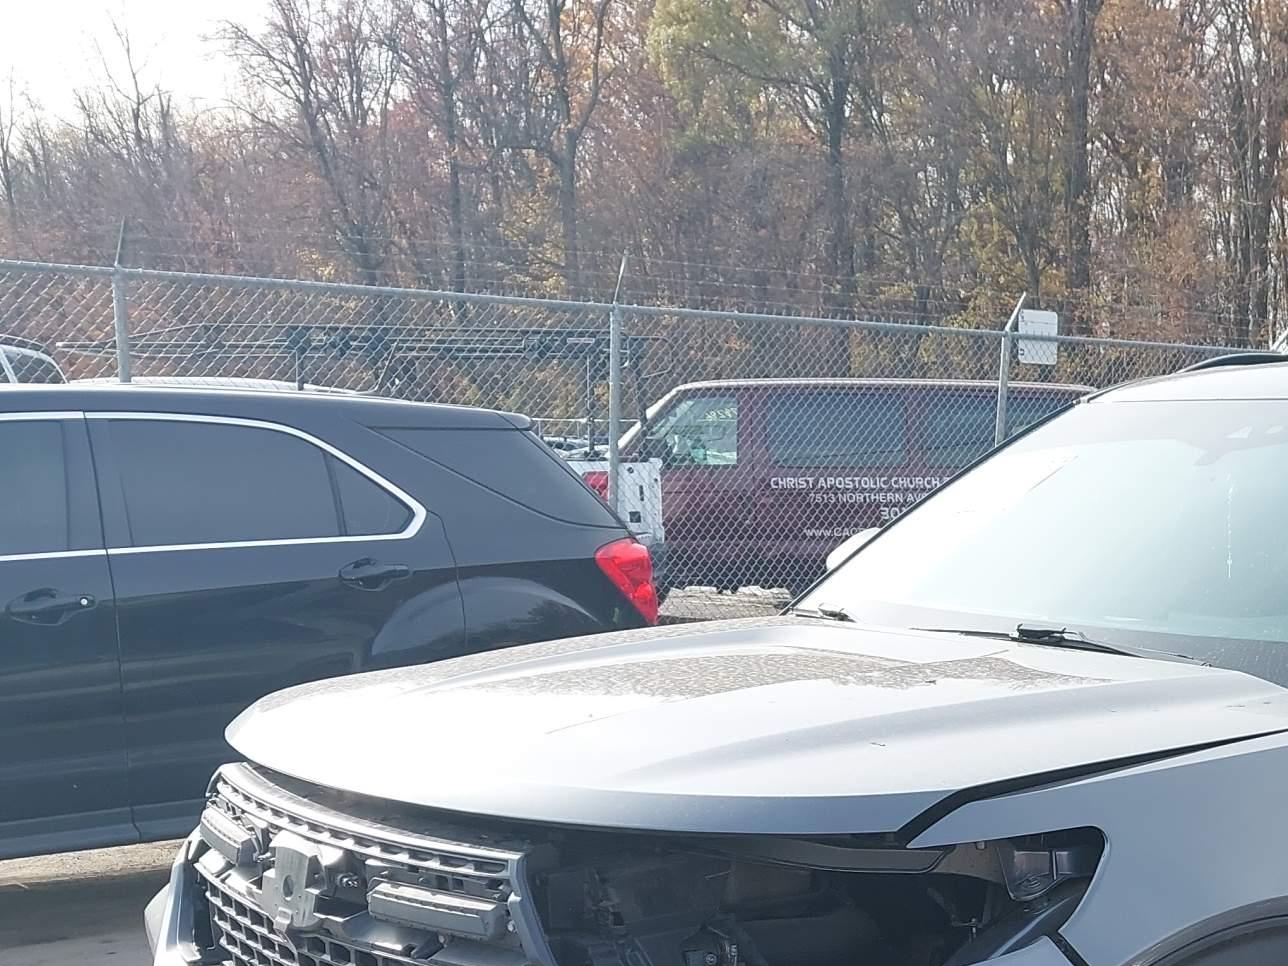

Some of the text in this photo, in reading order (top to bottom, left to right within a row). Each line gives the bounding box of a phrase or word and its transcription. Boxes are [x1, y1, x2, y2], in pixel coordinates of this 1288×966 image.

[770, 477, 815, 489] CHRIST
[817, 477, 889, 489] APOSTOLIC
[891, 477, 940, 489] CHURCH
[809, 492, 836, 503] 7513
[838, 492, 904, 503] NORTHERN
